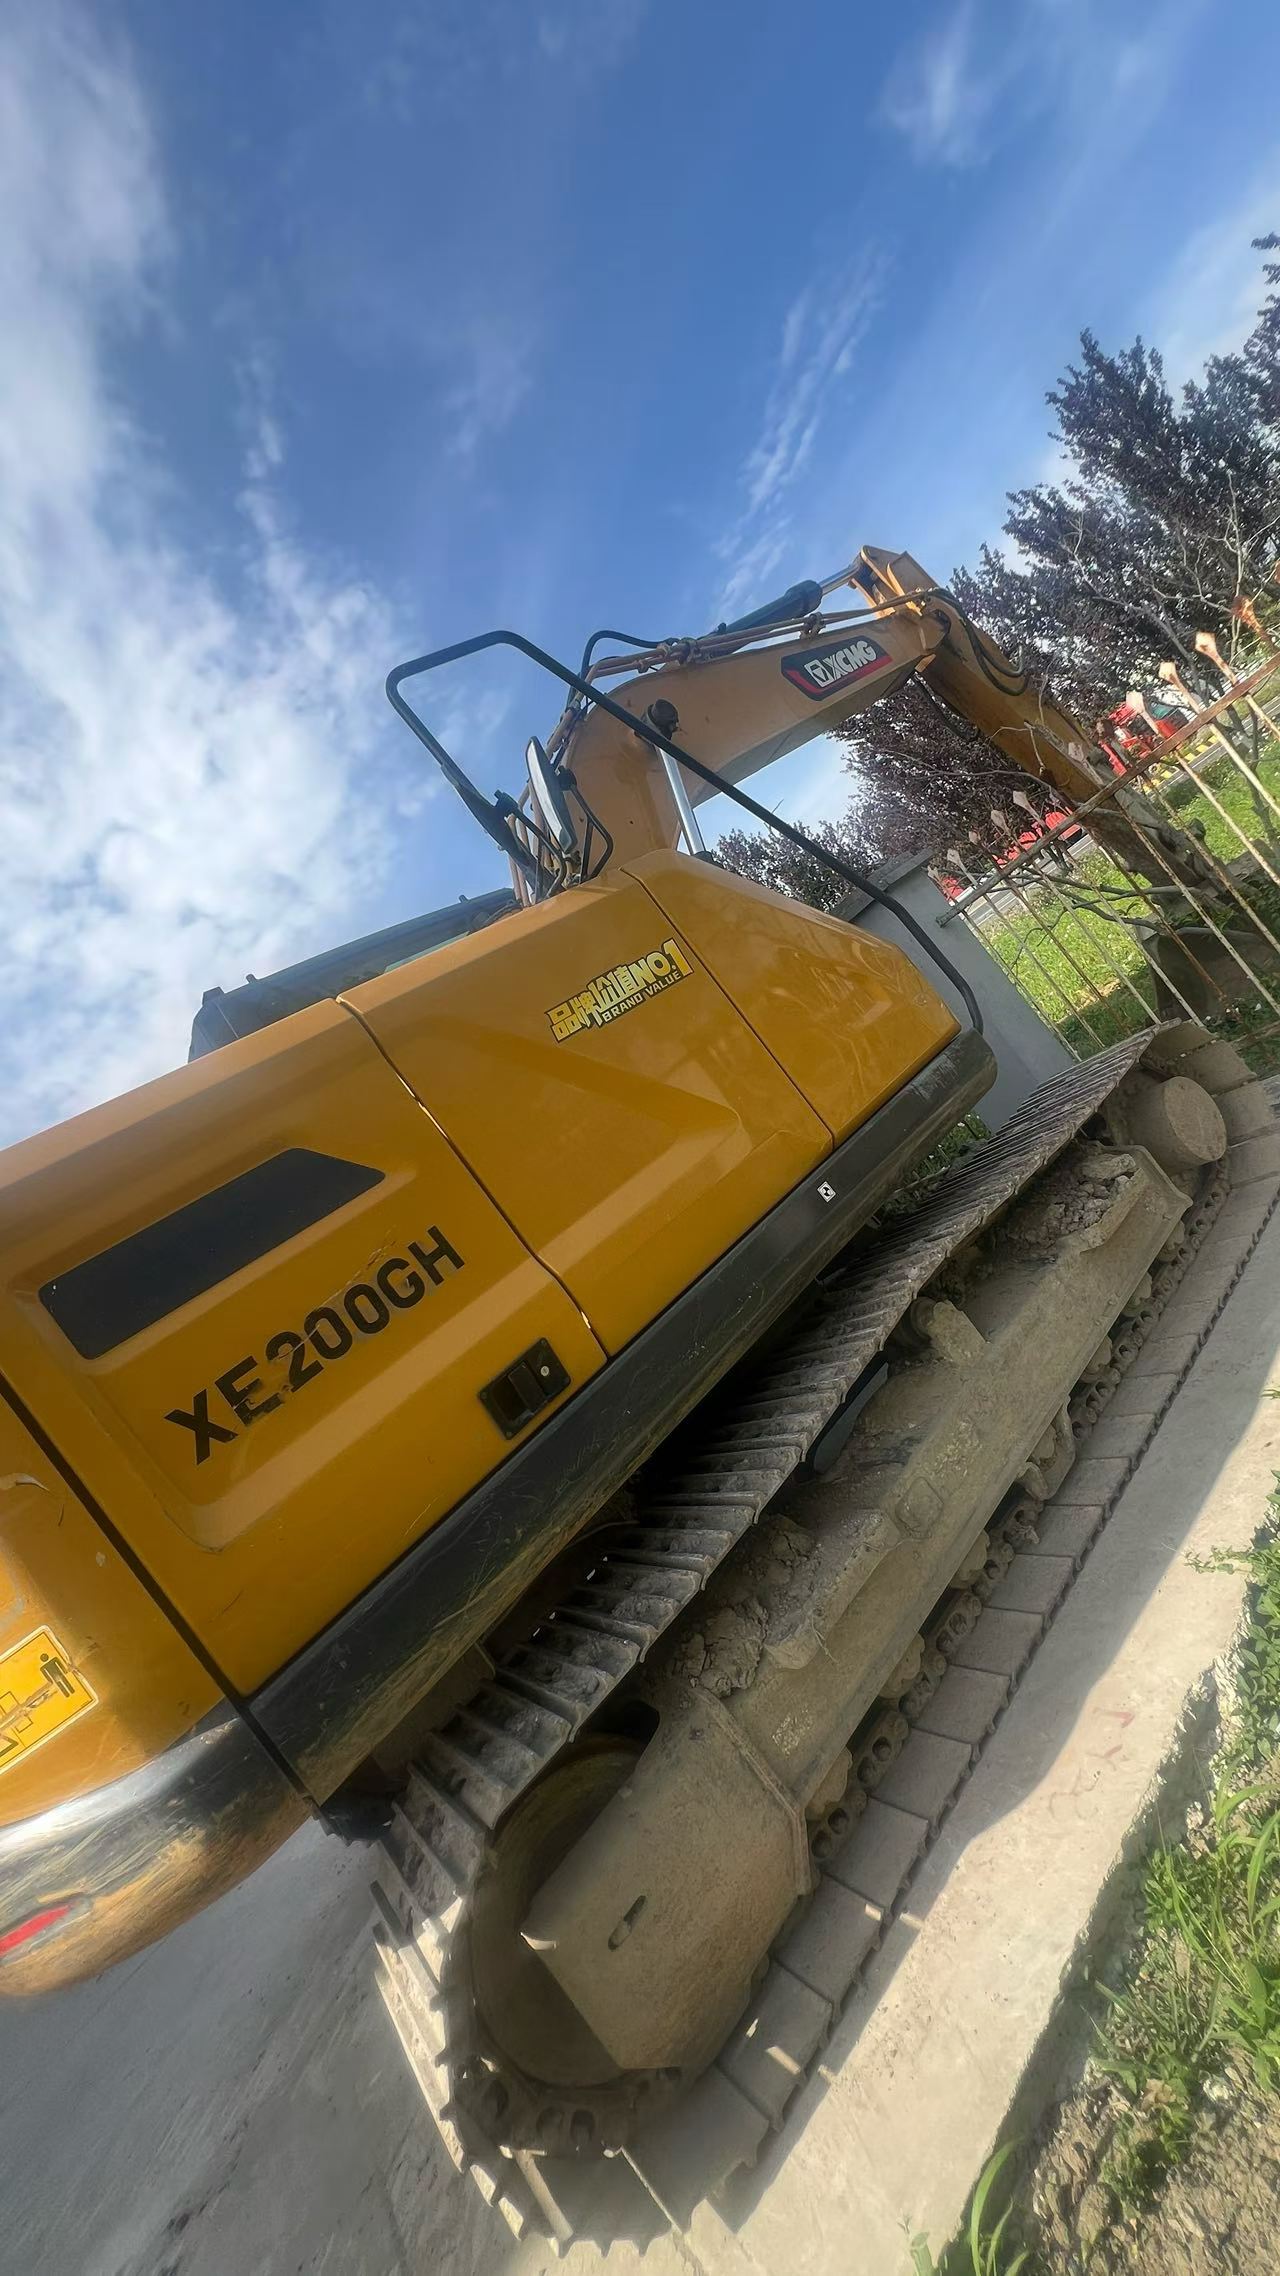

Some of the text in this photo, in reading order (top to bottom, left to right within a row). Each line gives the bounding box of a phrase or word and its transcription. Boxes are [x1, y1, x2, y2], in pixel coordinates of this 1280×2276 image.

[822, 640, 877, 681] XCMG
[602, 971, 681, 1023] BRAND VALUE
[164, 1225, 466, 1465] XE200GH
